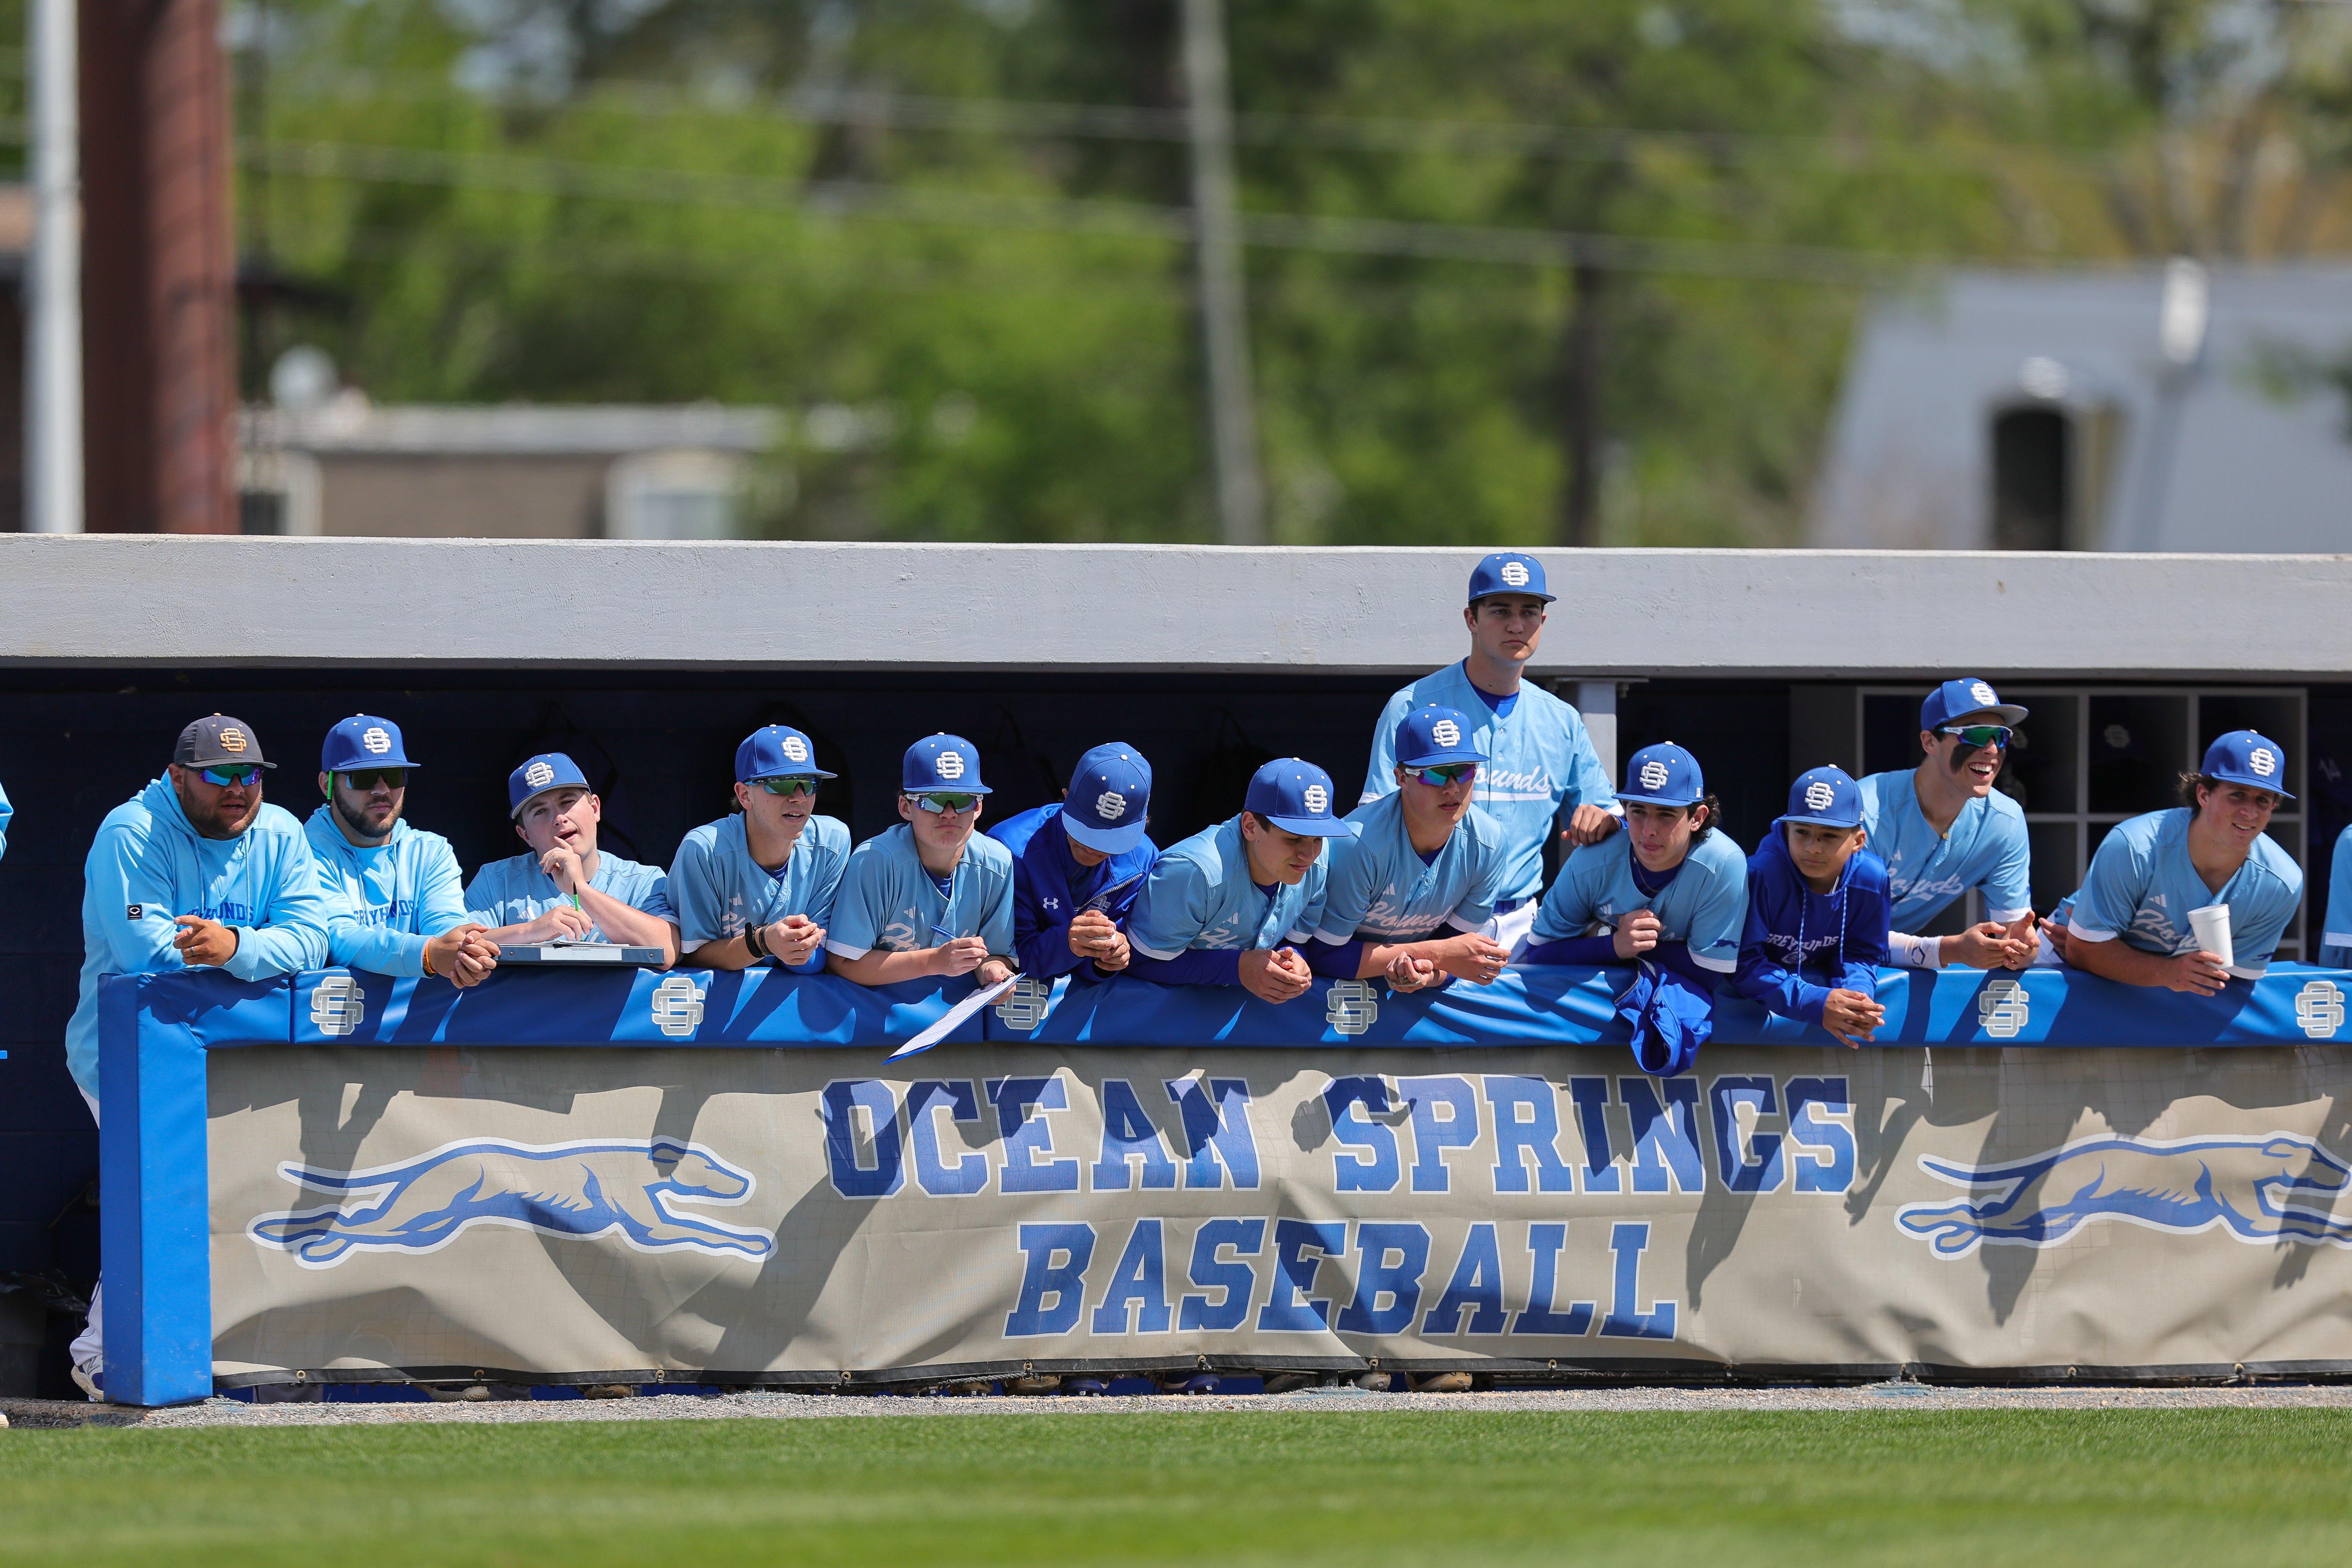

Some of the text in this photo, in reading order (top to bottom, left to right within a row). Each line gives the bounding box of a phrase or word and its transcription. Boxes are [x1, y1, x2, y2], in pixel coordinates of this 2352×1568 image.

[1474, 765, 1549, 792] ounds
[1365, 901, 1453, 928] Hound
[818, 1074, 1858, 1200] OCEAN SPRINGS
[1001, 1216, 1679, 1341] BASEBALL
